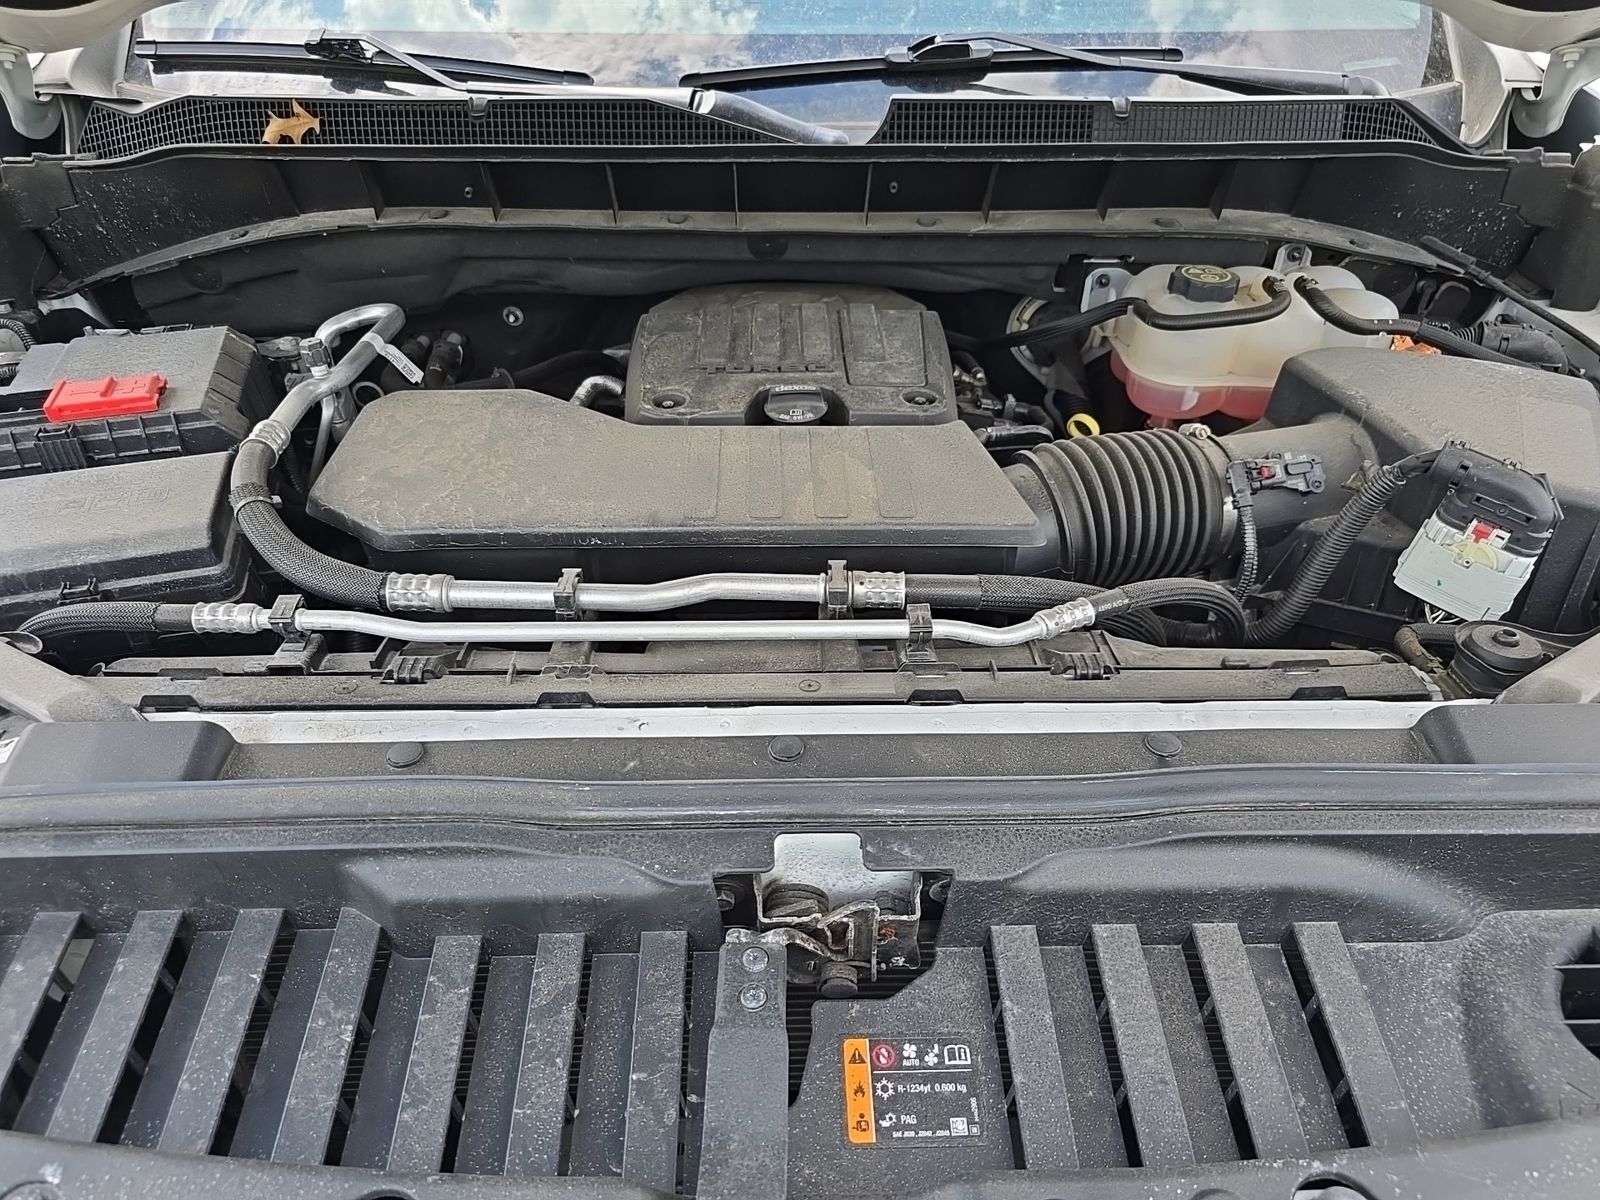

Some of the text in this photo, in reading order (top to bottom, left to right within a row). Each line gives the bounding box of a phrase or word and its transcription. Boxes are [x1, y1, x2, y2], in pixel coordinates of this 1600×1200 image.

[902, 1058, 920, 1067] AUTO
[897, 1082, 967, 1094] R-1234yf 0.600 kg
[900, 1114, 917, 1125] PAG
